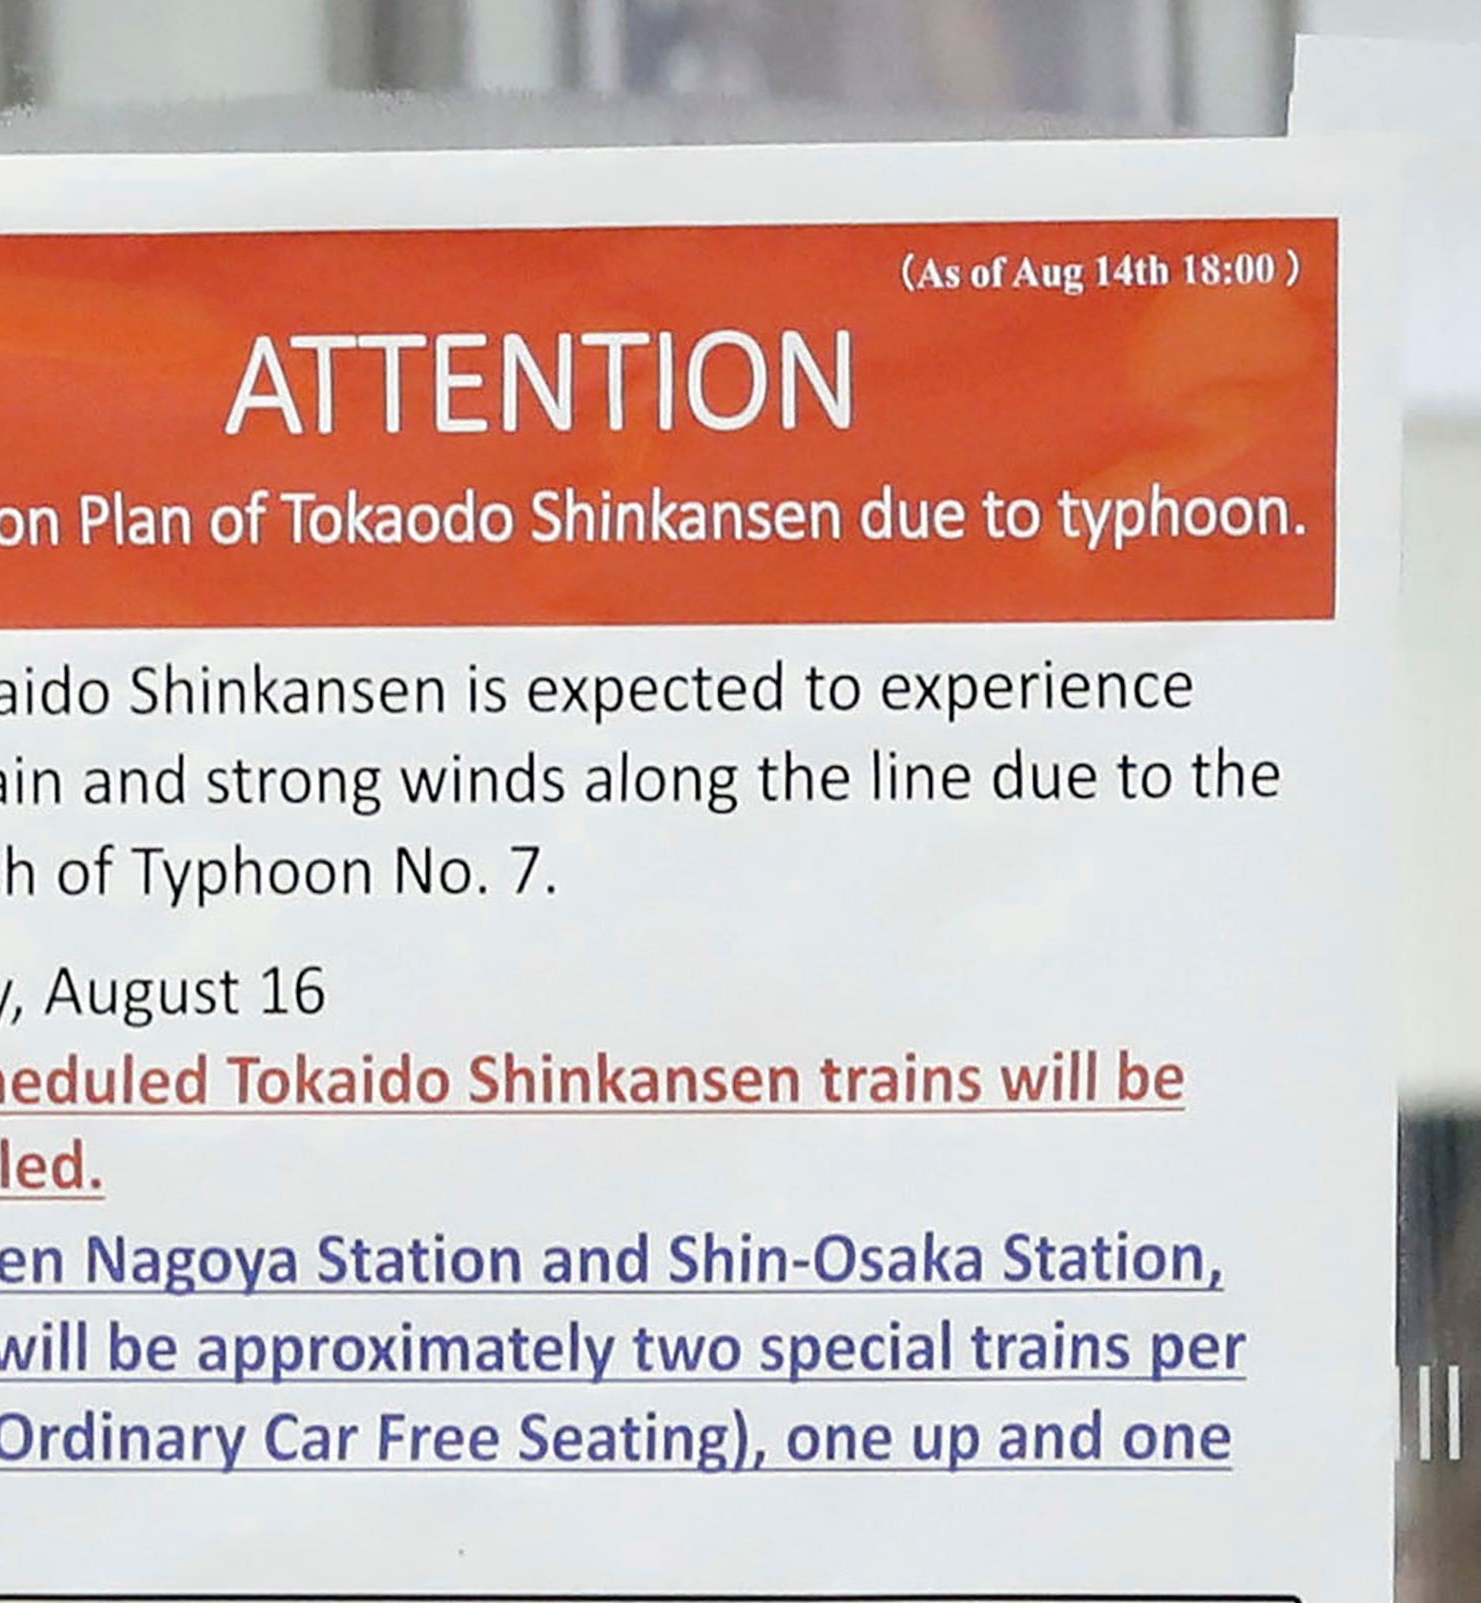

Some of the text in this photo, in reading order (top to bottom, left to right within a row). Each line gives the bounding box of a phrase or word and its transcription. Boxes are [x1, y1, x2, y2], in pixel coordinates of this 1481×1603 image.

[902, 252, 961, 292] (As
[971, 255, 1008, 287] of
[1014, 257, 1084, 295] Aug
[1096, 253, 1169, 286] 14th
[225, 330, 851, 434] ATTENTION
[81, 491, 190, 544] Plan
[211, 490, 269, 544] of
[280, 488, 513, 543] Tokaodo
[532, 487, 840, 542] Shinkansen
[861, 485, 965, 539] due
[982, 491, 1040, 538] to
[1058, 483, 1305, 550] typhoon.
[131, 663, 443, 714] Shinkansen
[470, 664, 506, 713] is
[528, 660, 782, 725] expected
[806, 667, 860, 711] to
[882, 660, 1192, 722] experience
[58, 844, 114, 895] of
[131, 844, 370, 908] Typhoon
[397, 847, 486, 894] No.
[511, 846, 554, 893] 7.
[45, 967, 238, 1027] August
[263, 966, 324, 1014] 16
[227, 1053, 449, 1104] Tokaido
[470, 1052, 799, 1103] Shinkansen
[820, 1052, 981, 1103] trains
[1001, 1050, 1096, 1101] will
[1119, 1050, 1183, 1100] be
[88, 1236, 296, 1295] Nagoya
[319, 1233, 520, 1283] Station
[543, 1232, 647, 1283] and
[670, 1231, 982, 1283] Shin-Osaka
[1004, 1231, 1221, 1291] Station,
[265, 1413, 358, 1461] Car
[379, 1414, 499, 1461] Free
[519, 1408, 765, 1472] Seating),
[788, 1425, 891, 1461] one
[914, 1424, 979, 1471] up
[1000, 1408, 1101, 1460] and
[1124, 1424, 1230, 1460] one
